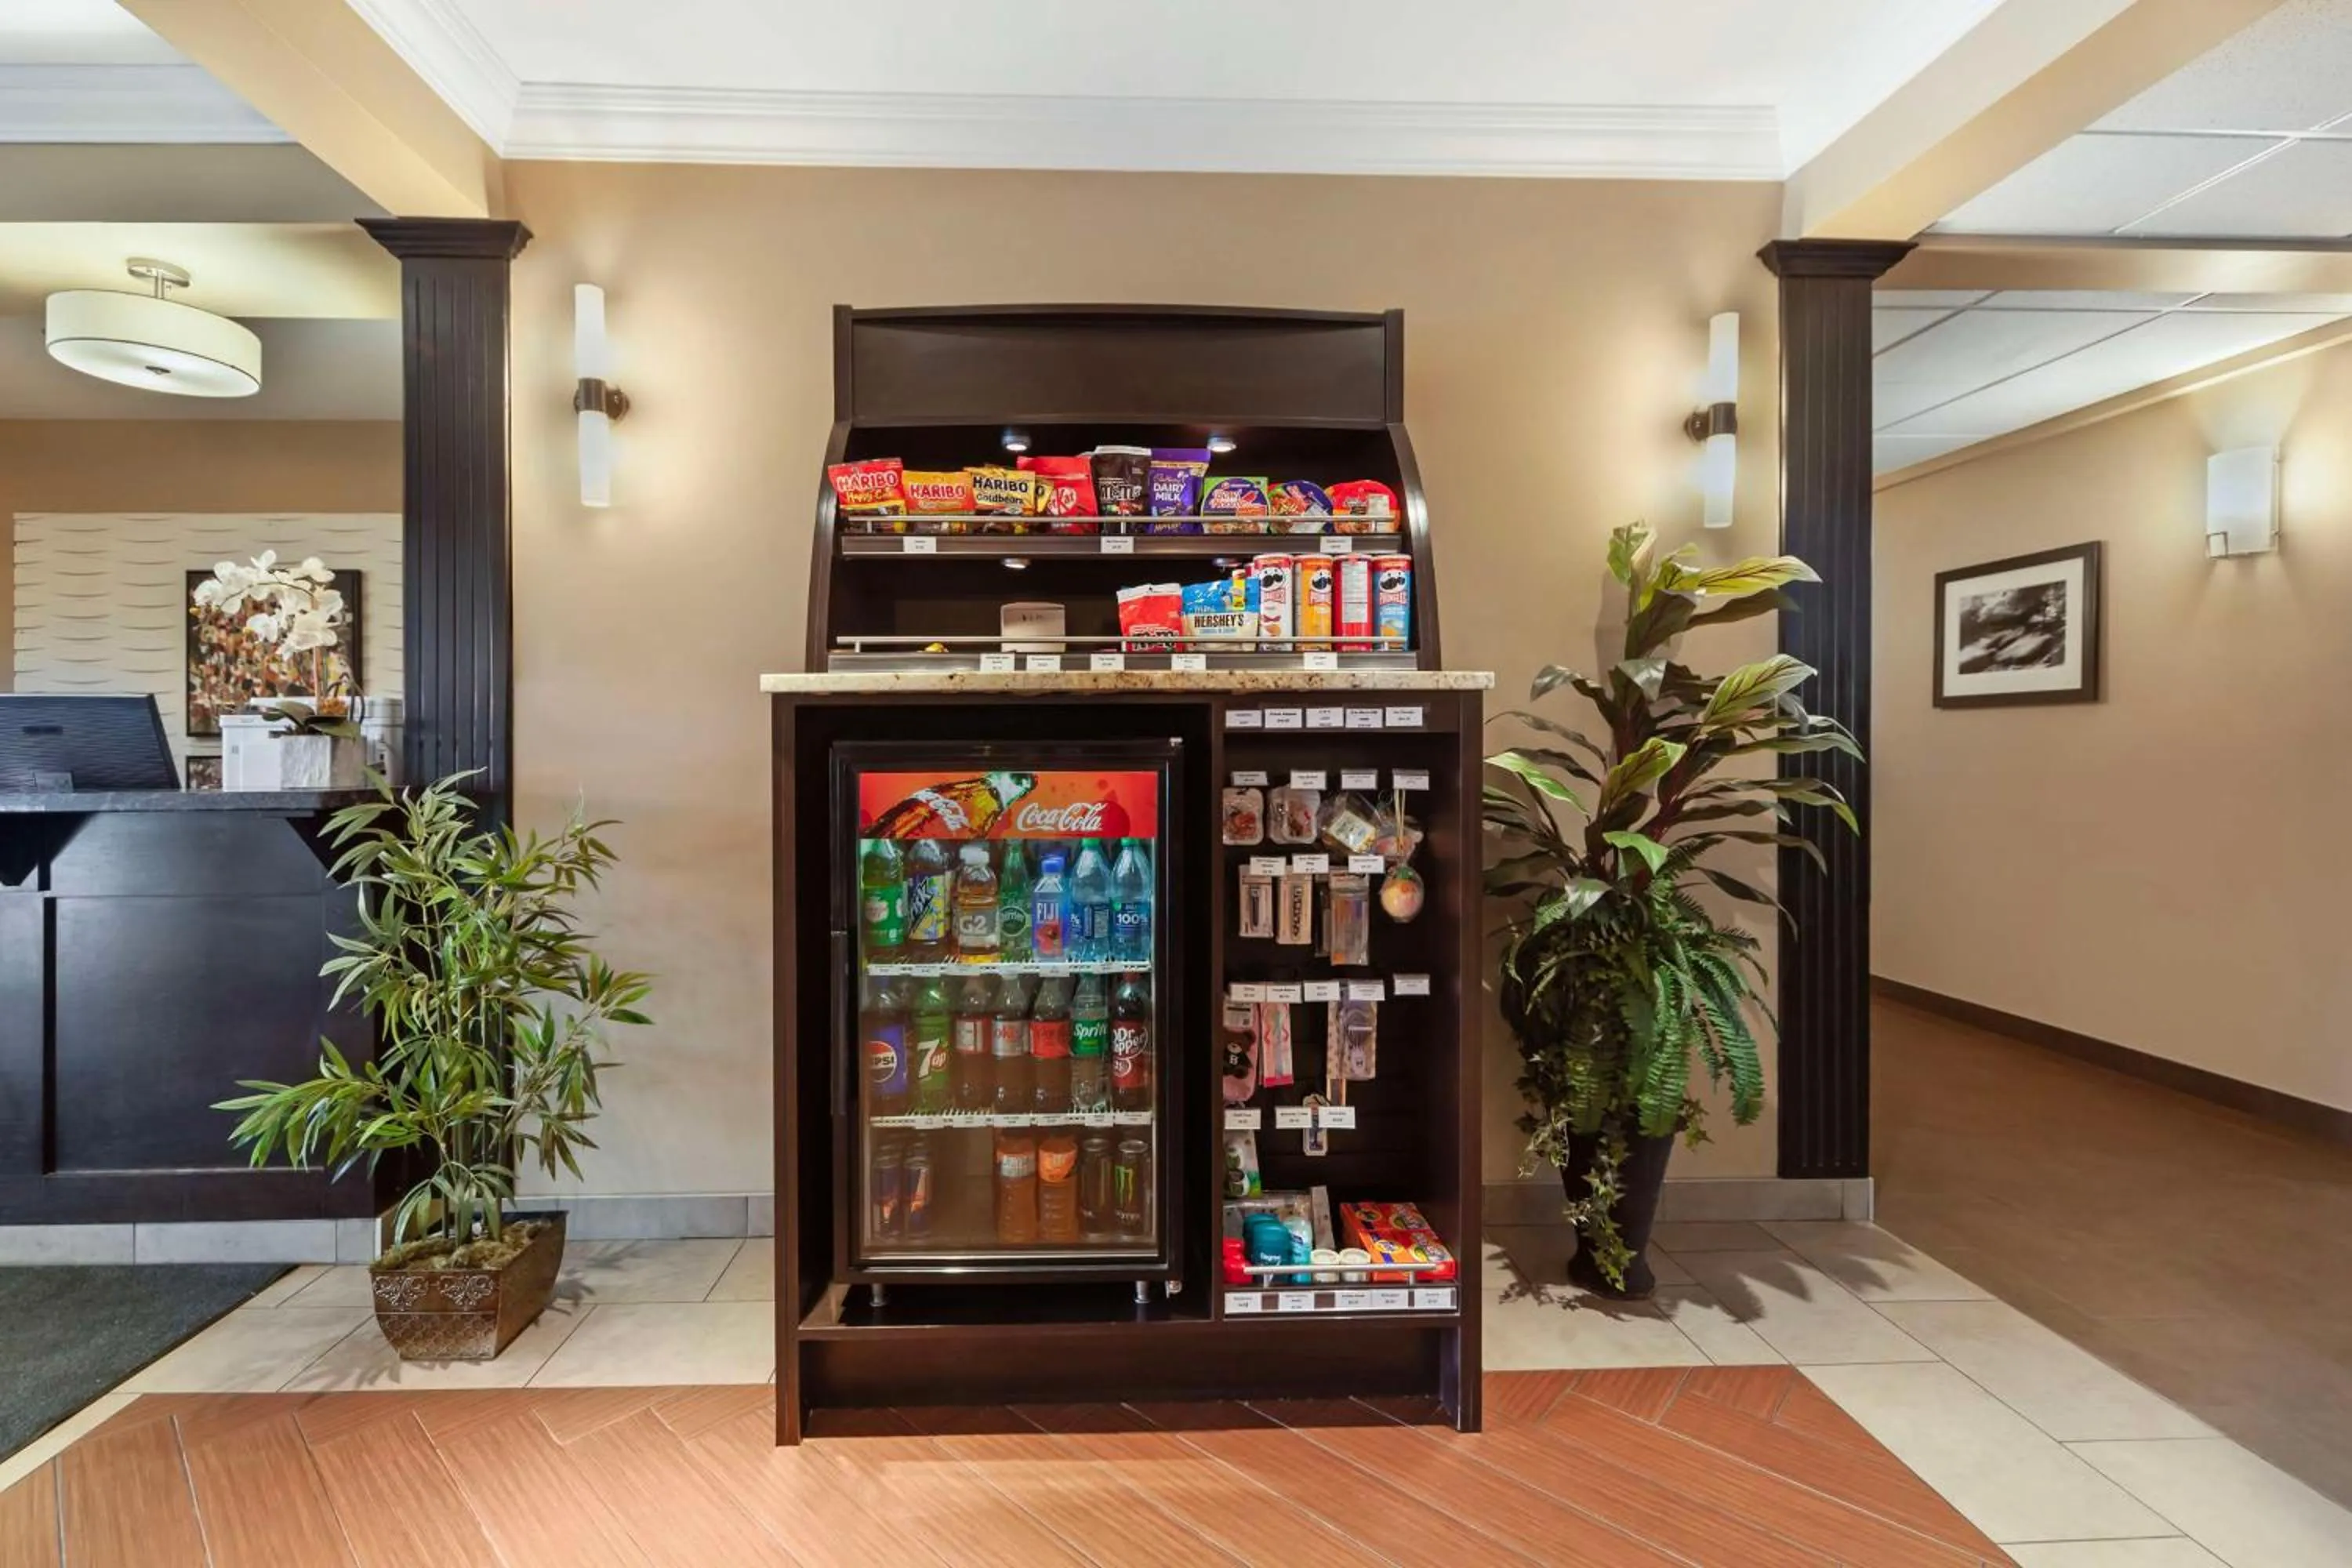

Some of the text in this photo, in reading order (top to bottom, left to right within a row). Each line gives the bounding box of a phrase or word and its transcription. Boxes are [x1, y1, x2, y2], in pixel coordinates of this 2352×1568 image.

[837, 472, 898, 492] HARIBO
[973, 476, 1029, 493] HARIBO
[1153, 483, 1186, 492] DAIRY
[910, 484, 966, 499] HARIBO
[1155, 492, 1180, 501] MILK
[1017, 802, 1108, 831] Coca-Cola
[1036, 902, 1059, 924] FIJI
[959, 915, 987, 935] G2
